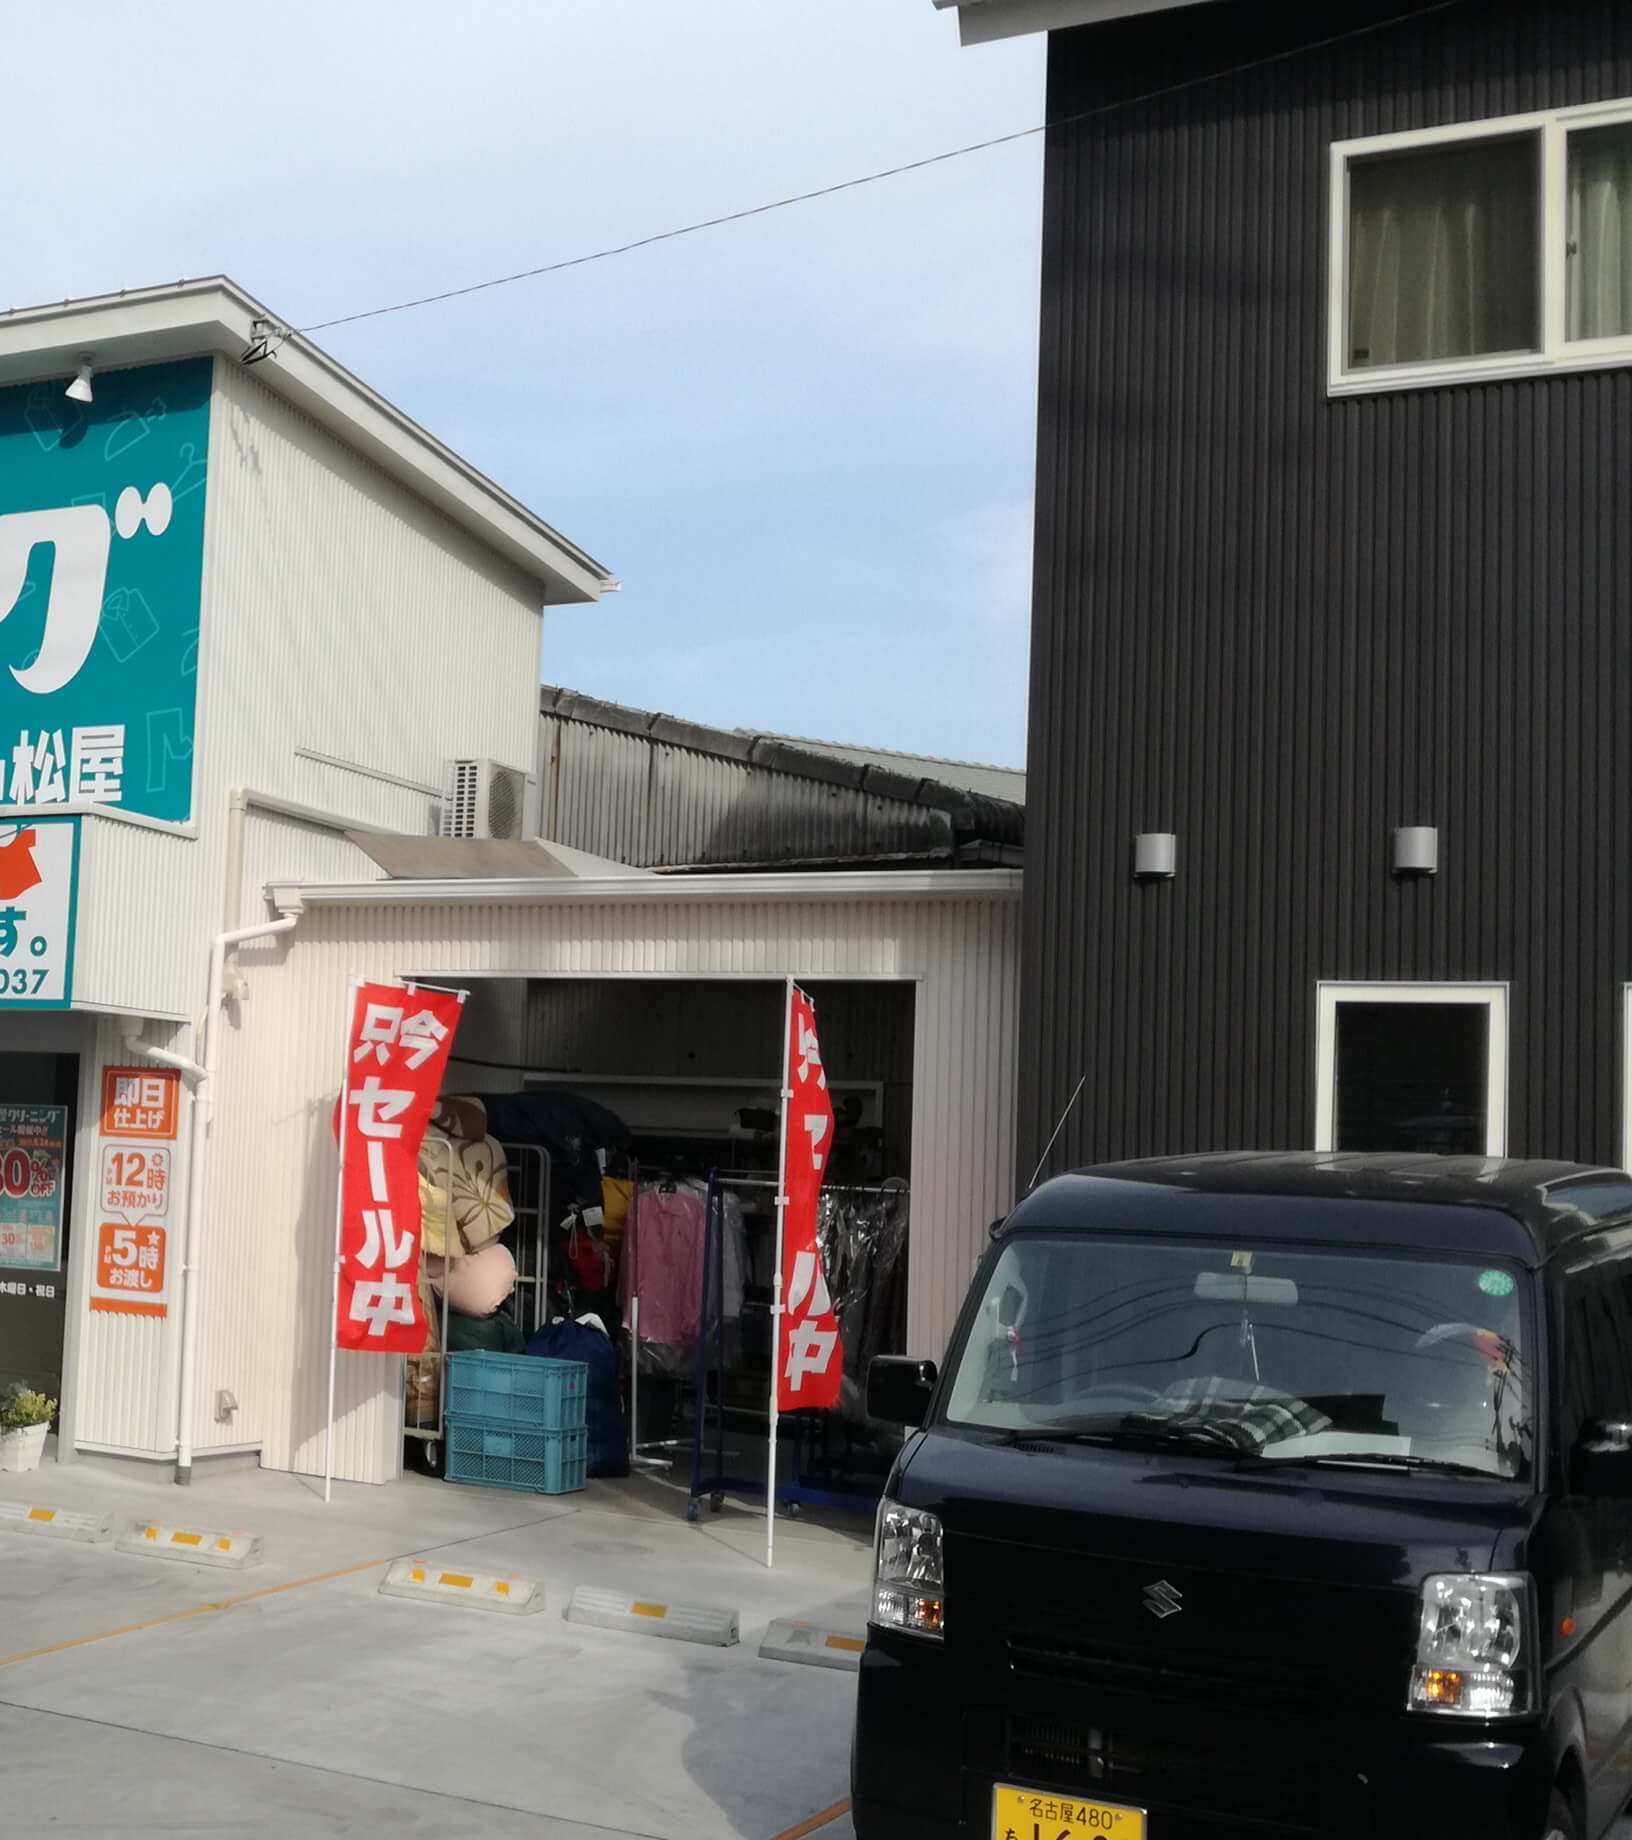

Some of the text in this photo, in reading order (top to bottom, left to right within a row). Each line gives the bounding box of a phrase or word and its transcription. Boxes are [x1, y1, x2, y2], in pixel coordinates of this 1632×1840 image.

[114, 1077, 166, 1109] 即日
[113, 1108, 165, 1130] 仕上げ
[107, 1190, 165, 1209] お預かり
[109, 1268, 153, 1289] お渡し
